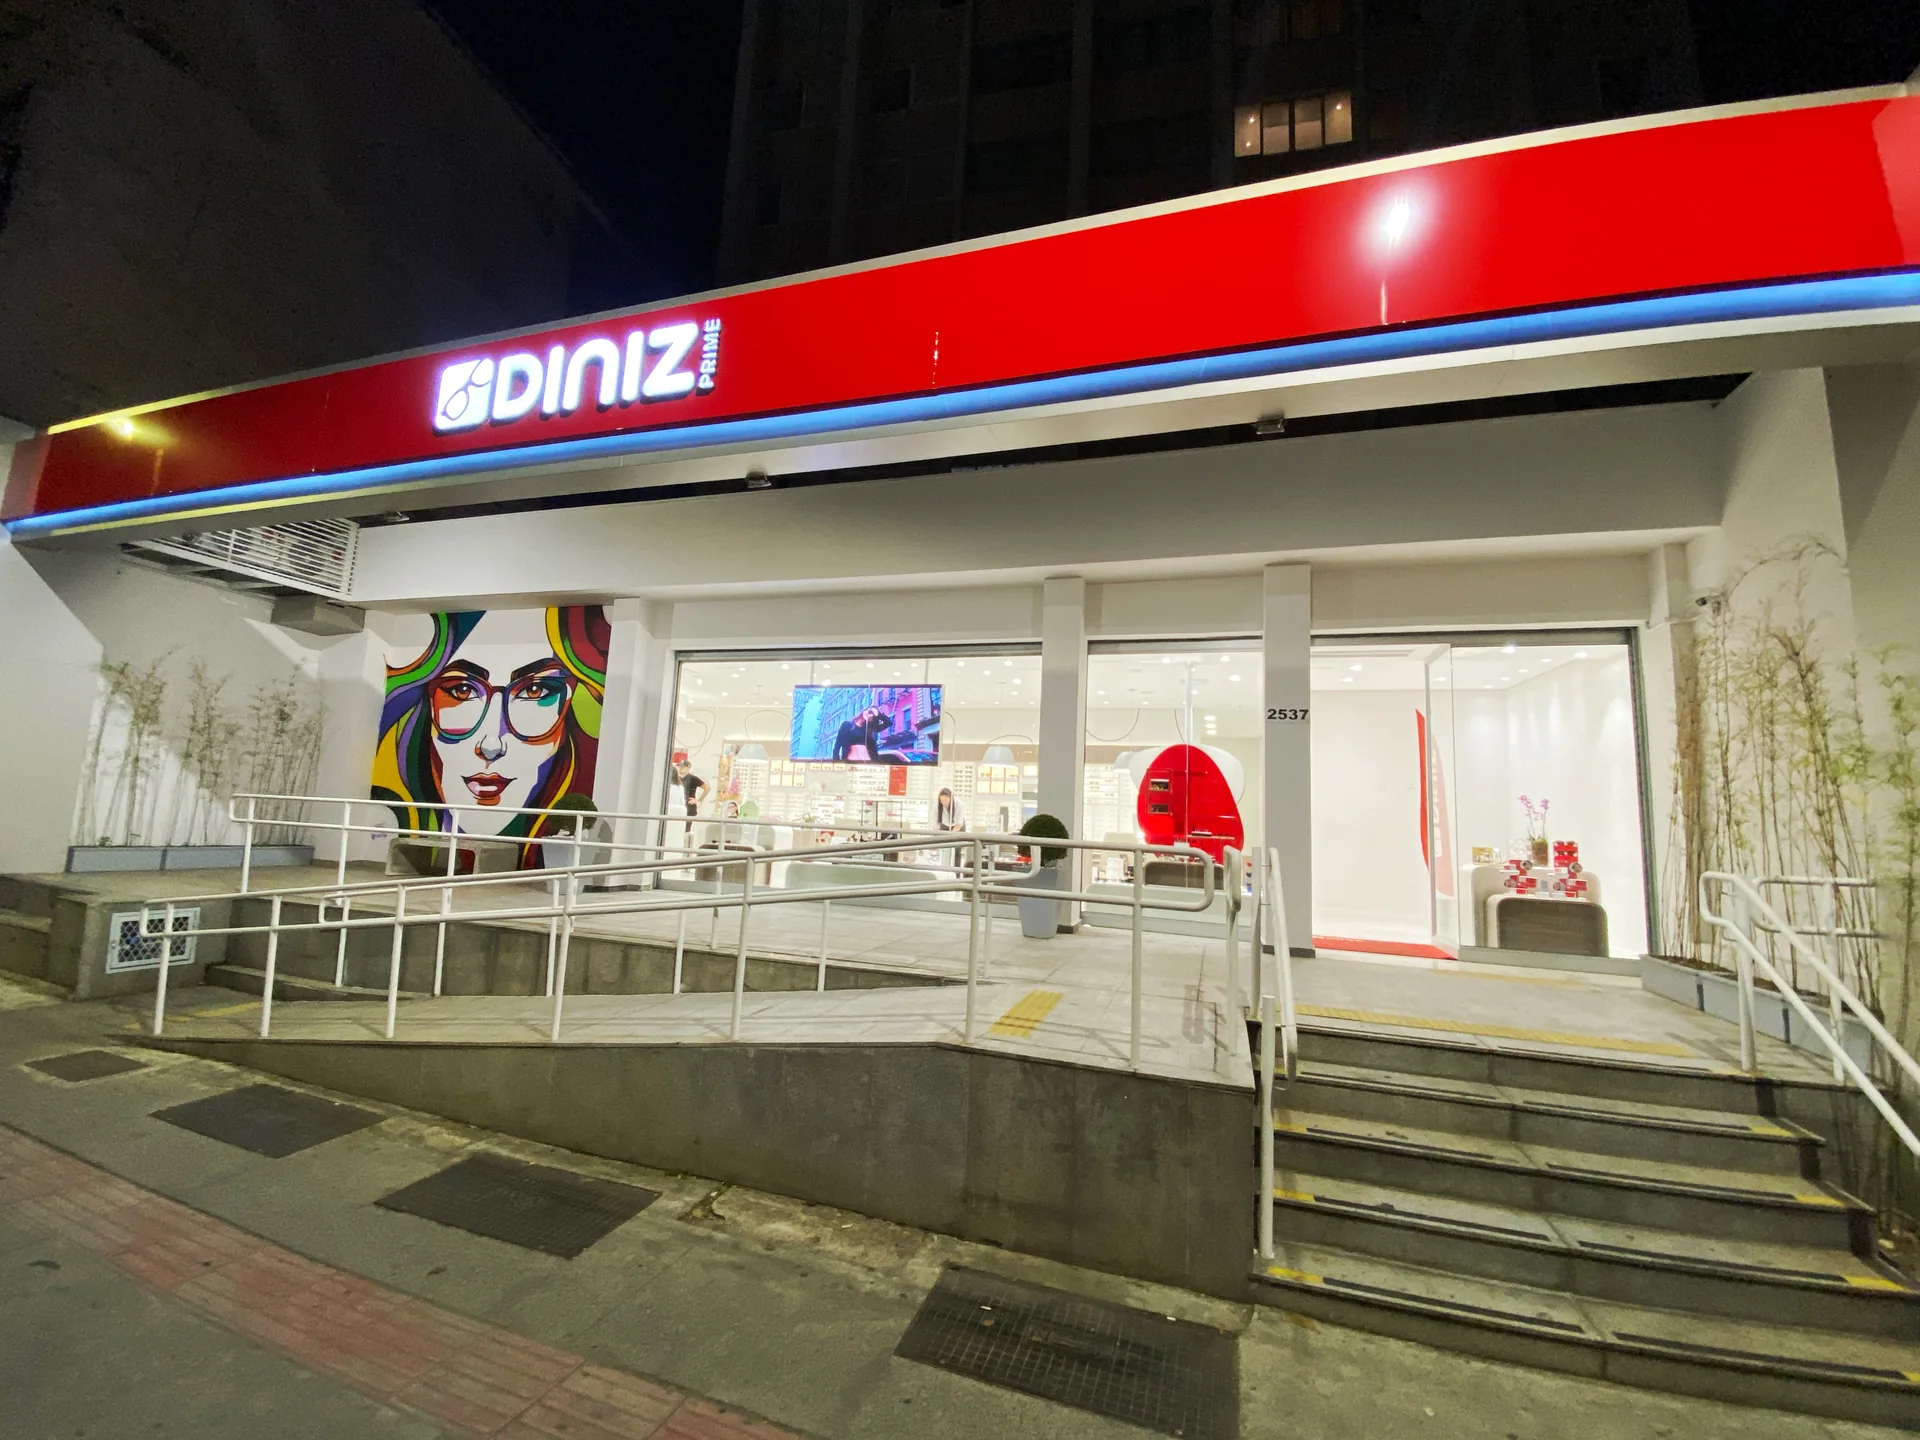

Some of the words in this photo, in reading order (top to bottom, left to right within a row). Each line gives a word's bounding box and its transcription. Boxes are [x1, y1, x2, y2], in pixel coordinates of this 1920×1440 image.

[491, 322, 700, 421] DINIZ
[698, 317, 722, 389] PRIME
[1267, 708, 1309, 720] 2537
